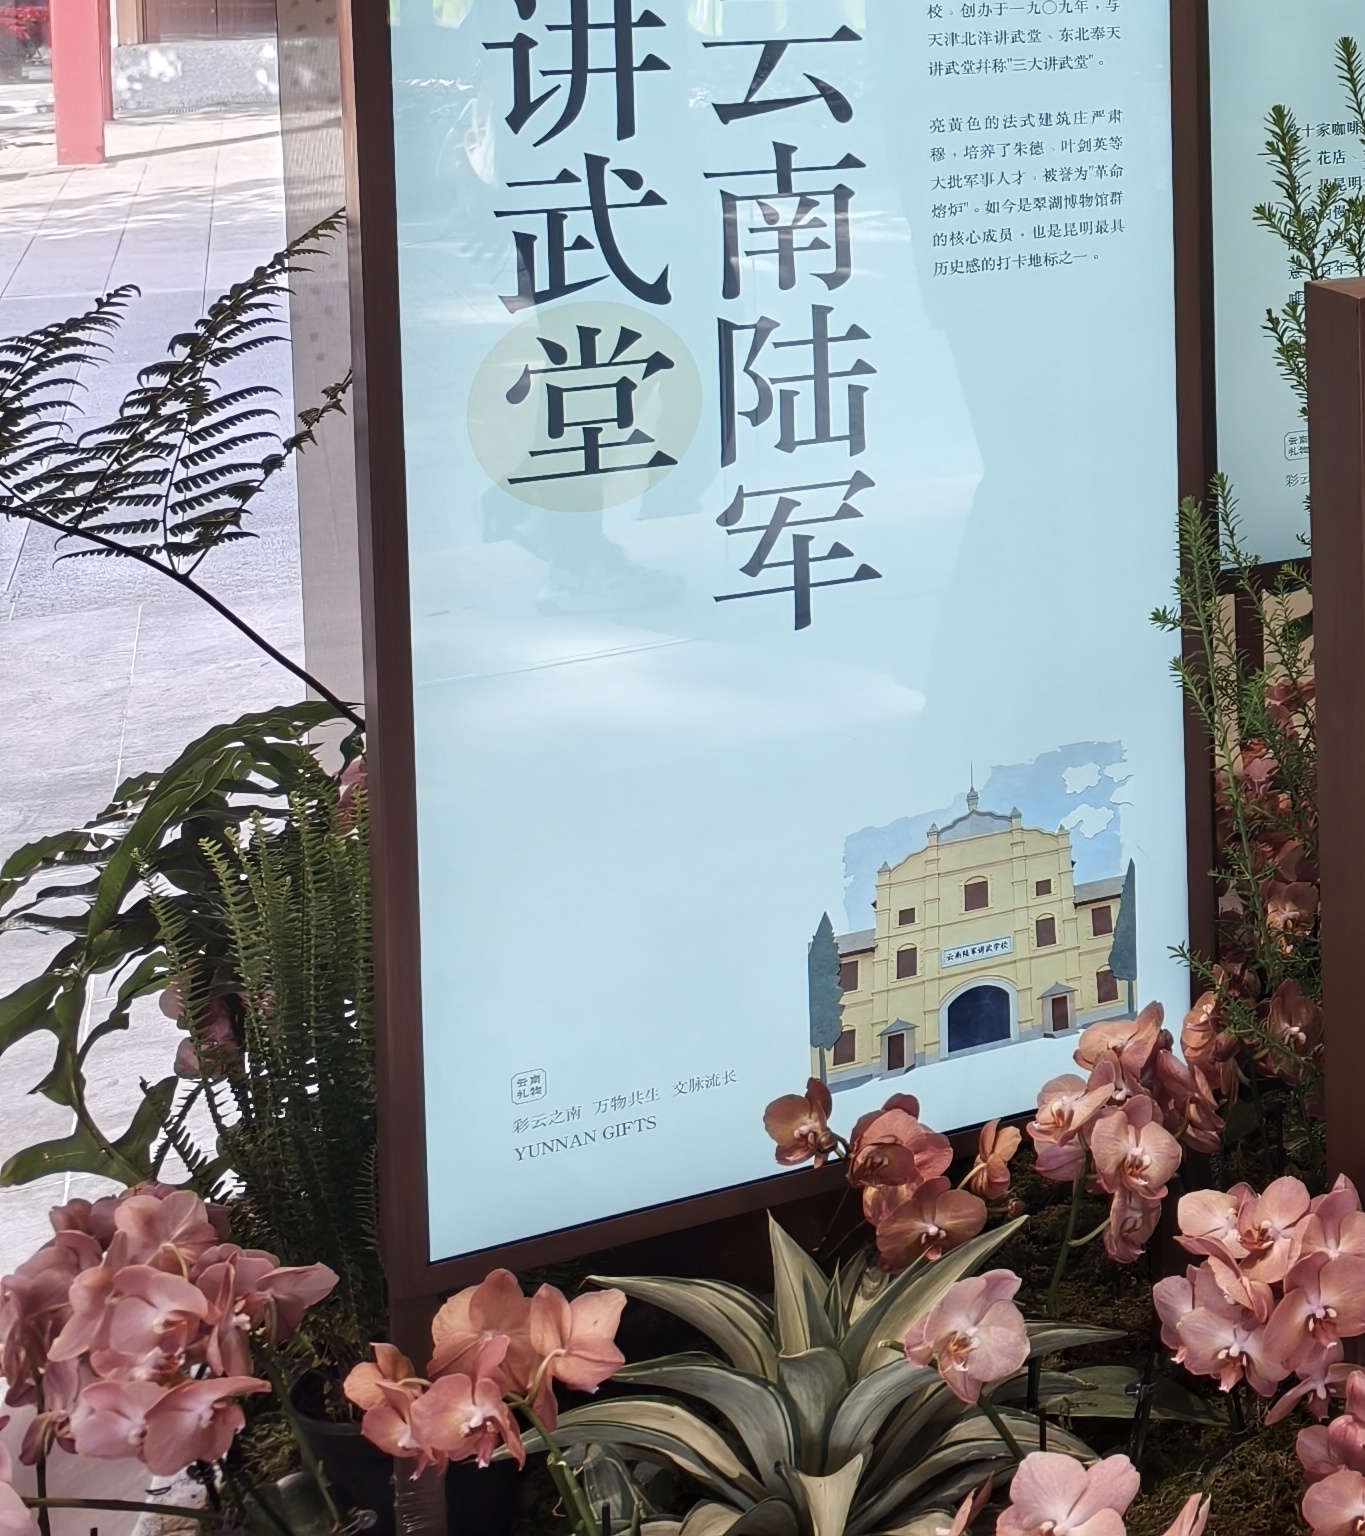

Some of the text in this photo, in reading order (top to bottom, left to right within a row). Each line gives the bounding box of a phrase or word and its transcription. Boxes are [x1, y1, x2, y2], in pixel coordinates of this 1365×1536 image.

[927, 25, 1121, 47] 天津北洋讲武堂、东北奉天
[929, 135, 1123, 163] 穆，培养了朱德、叶剑英等
[932, 218, 1126, 247] 的核心成员，也是昆明最具
[933, 250, 1099, 277] 历史感的打卡地标之一。
[512, 1069, 738, 1134] 彩云之南 万物共生 文脉流长
[513, 1115, 658, 1162] YUNNAN GIFTS
